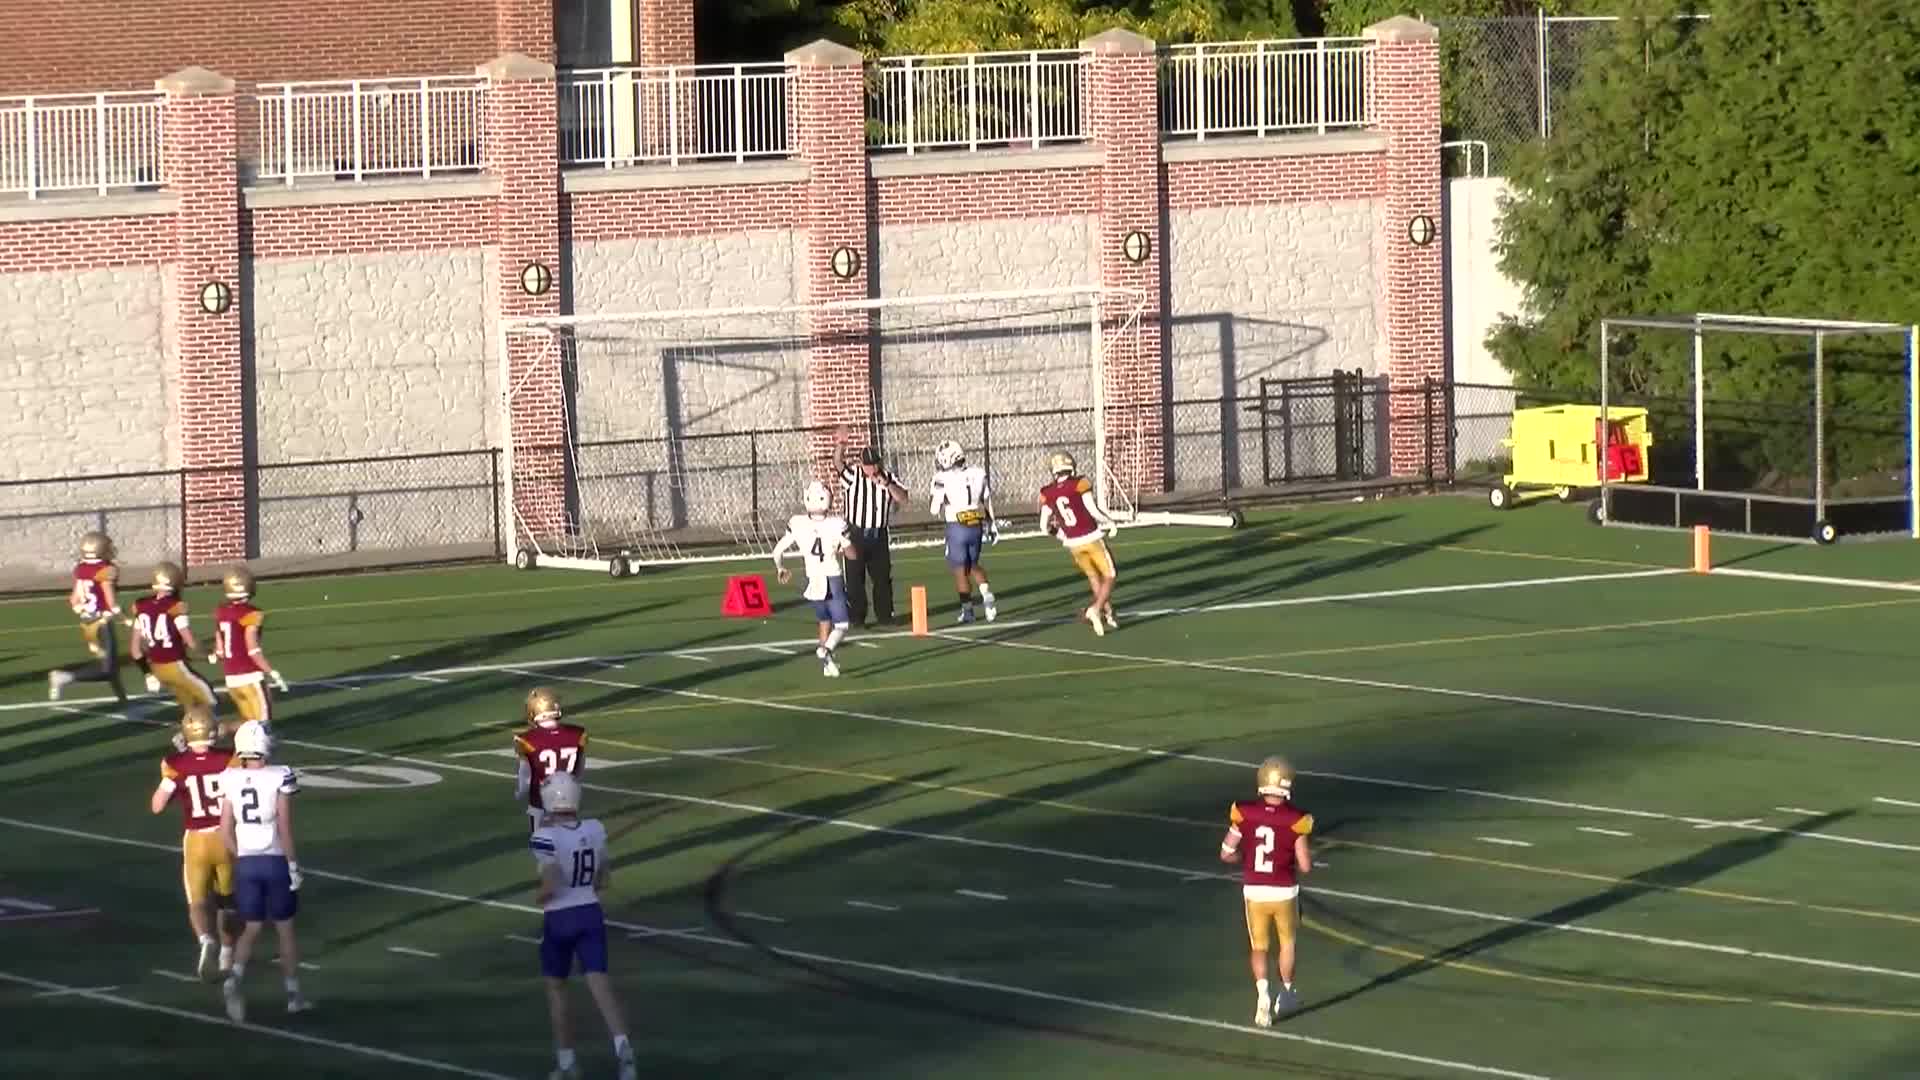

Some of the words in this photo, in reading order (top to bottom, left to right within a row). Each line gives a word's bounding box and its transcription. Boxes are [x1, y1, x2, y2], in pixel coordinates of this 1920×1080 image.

[966, 485, 972, 505] 1
[1056, 496, 1077, 527] 6
[811, 537, 825, 562] 4
[740, 581, 764, 608] G
[539, 747, 578, 780] 37
[241, 788, 261, 824] 2
[1255, 825, 1275, 873] 2
[571, 849, 595, 888] 18
